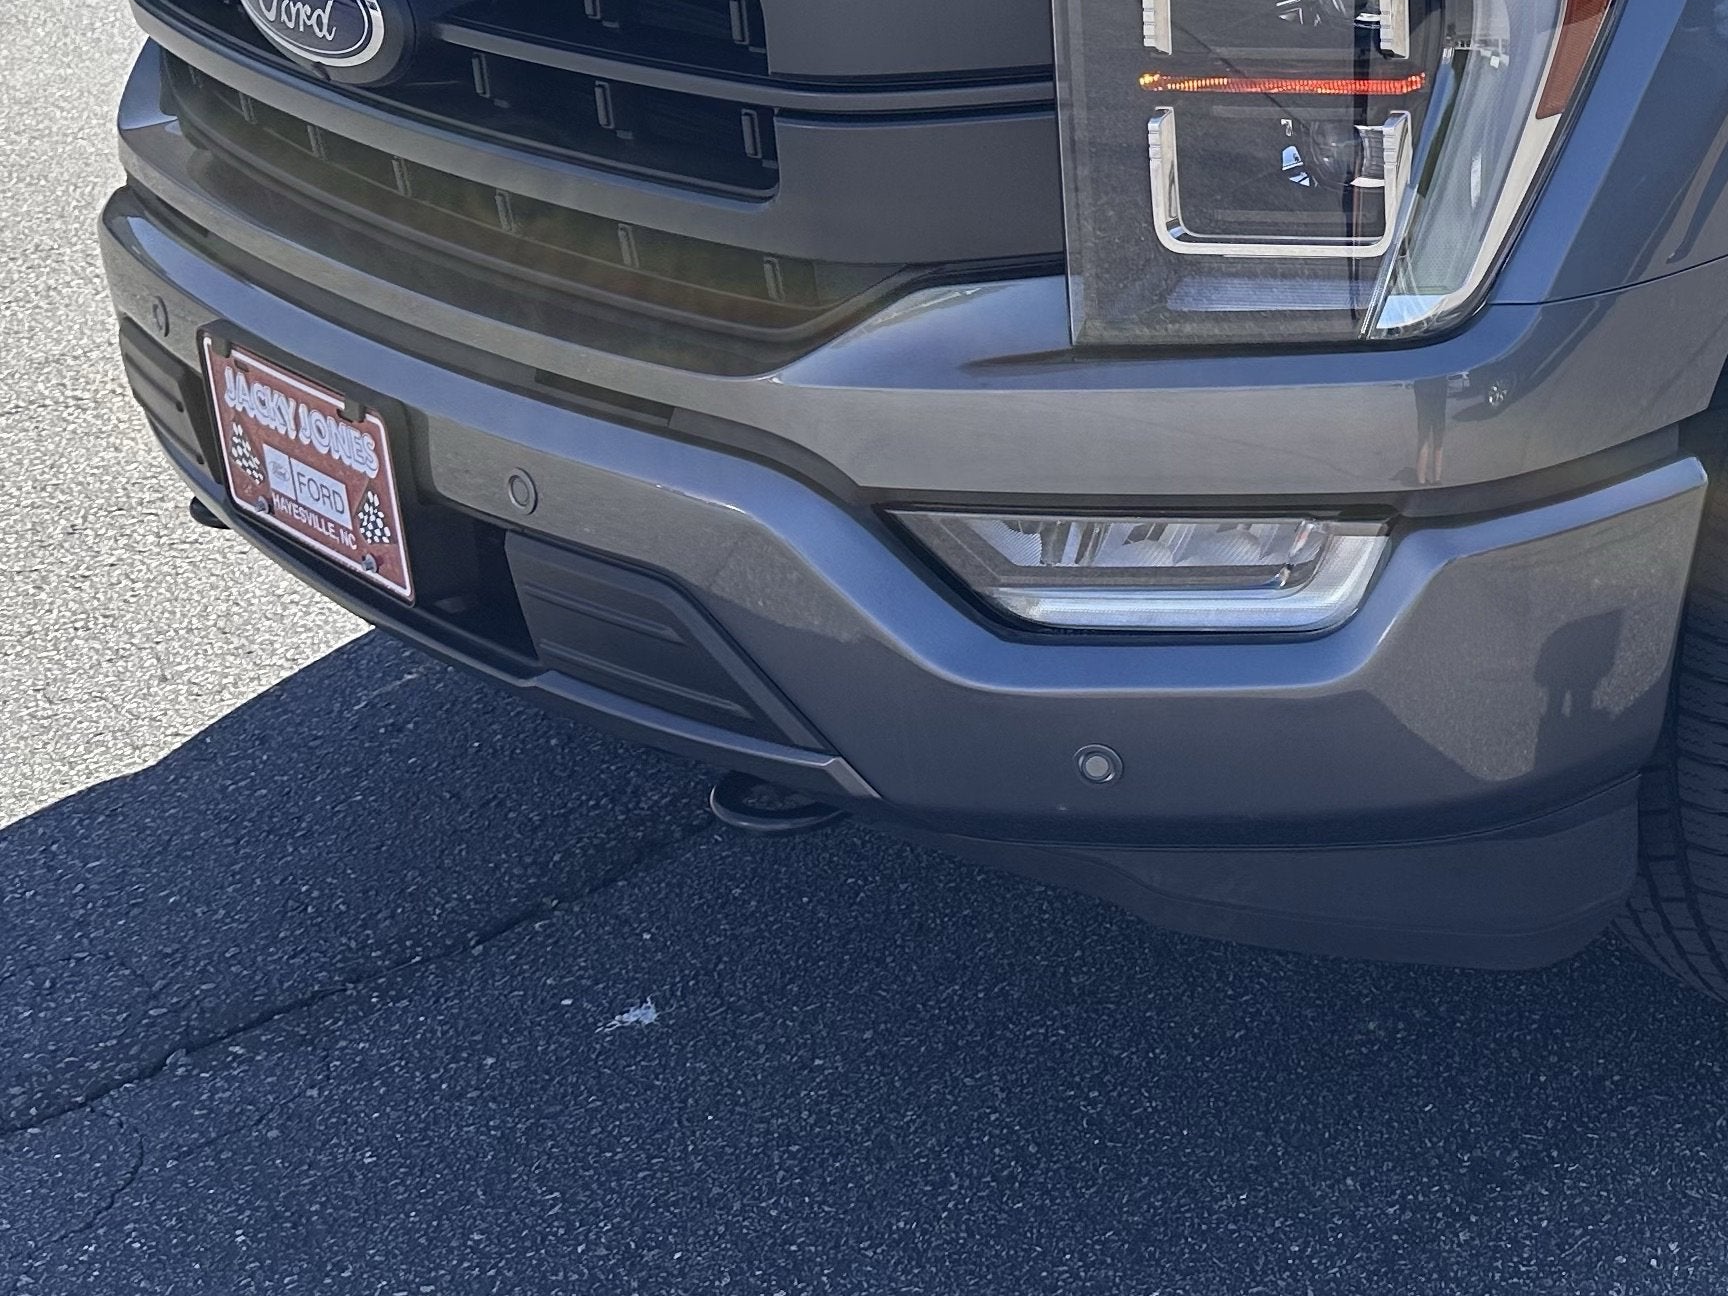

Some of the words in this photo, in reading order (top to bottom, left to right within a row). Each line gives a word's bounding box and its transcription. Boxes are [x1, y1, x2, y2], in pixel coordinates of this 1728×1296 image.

[224, 366, 297, 440] JACKY
[299, 403, 379, 479] JONES
[272, 491, 340, 543] HAYESVILLE,
[339, 528, 358, 550] NC
[296, 471, 345, 515] FORD
